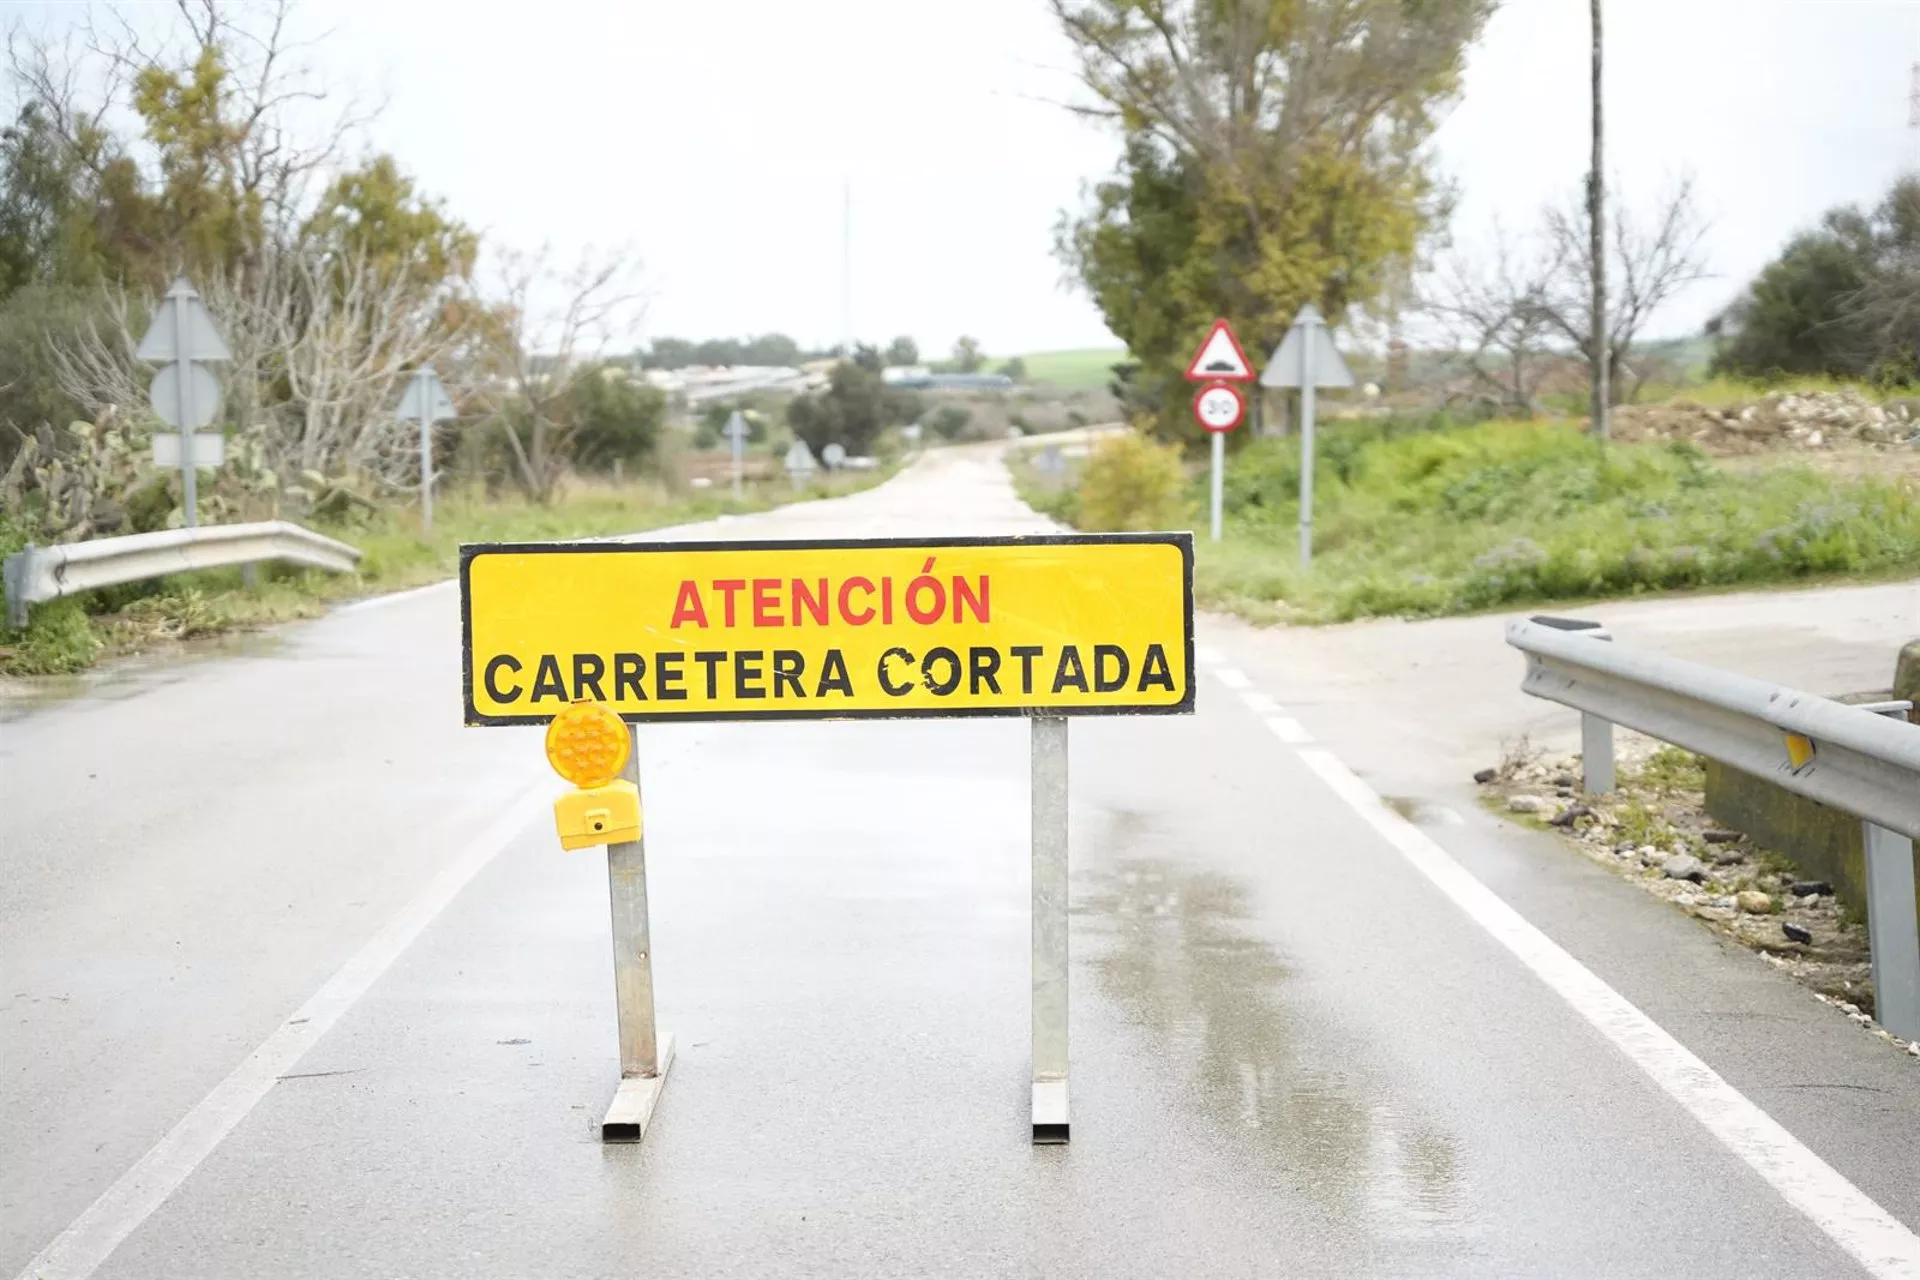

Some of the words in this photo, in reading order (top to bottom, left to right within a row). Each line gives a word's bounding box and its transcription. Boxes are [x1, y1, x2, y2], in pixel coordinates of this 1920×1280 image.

[670, 557, 990, 628] ATENCIÓN
[484, 649, 854, 704] CARRETERA
[877, 644, 1176, 697] CORTADA
